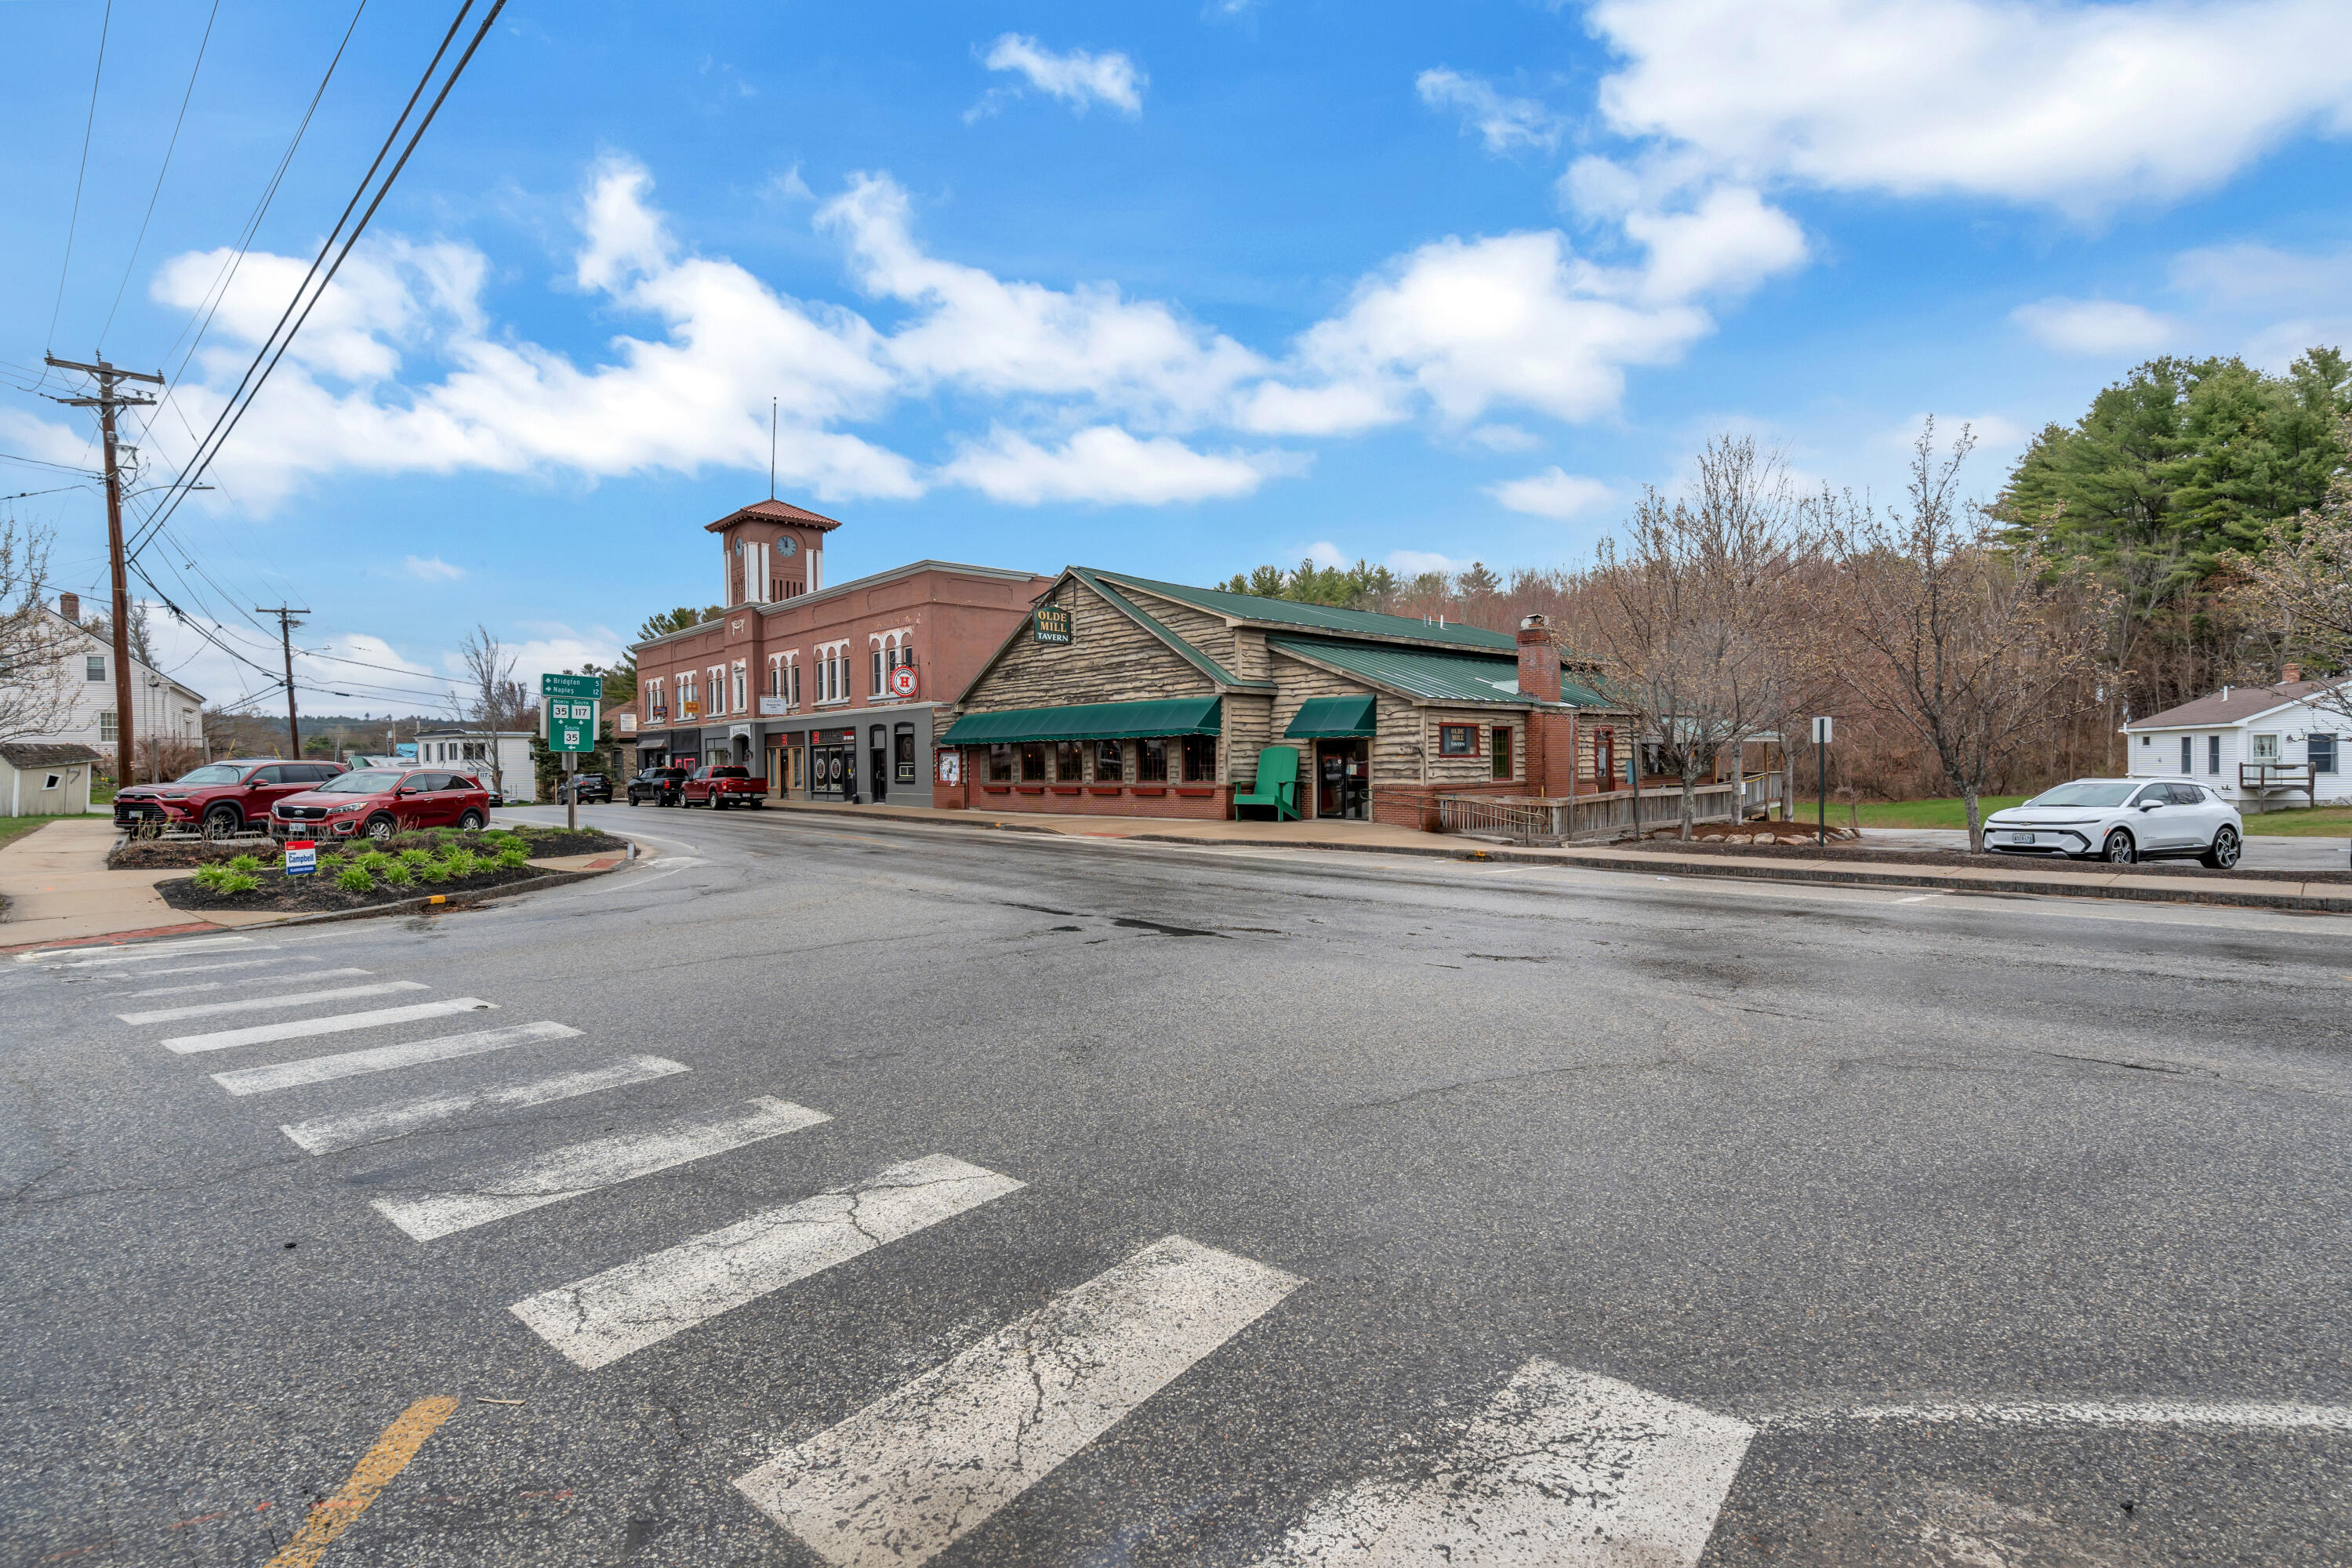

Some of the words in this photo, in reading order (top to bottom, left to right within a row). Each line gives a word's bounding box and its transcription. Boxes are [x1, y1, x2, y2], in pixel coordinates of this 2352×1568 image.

[1037, 611, 1067, 622] OLDE
[1040, 621, 1067, 633] MILL
[1037, 632, 1069, 641] TAVERN
[554, 677, 580, 686] Bridgton
[899, 676, 910, 688] H
[555, 707, 568, 716] 35
[575, 708, 587, 717] 117
[289, 854, 314, 863] Campbell
